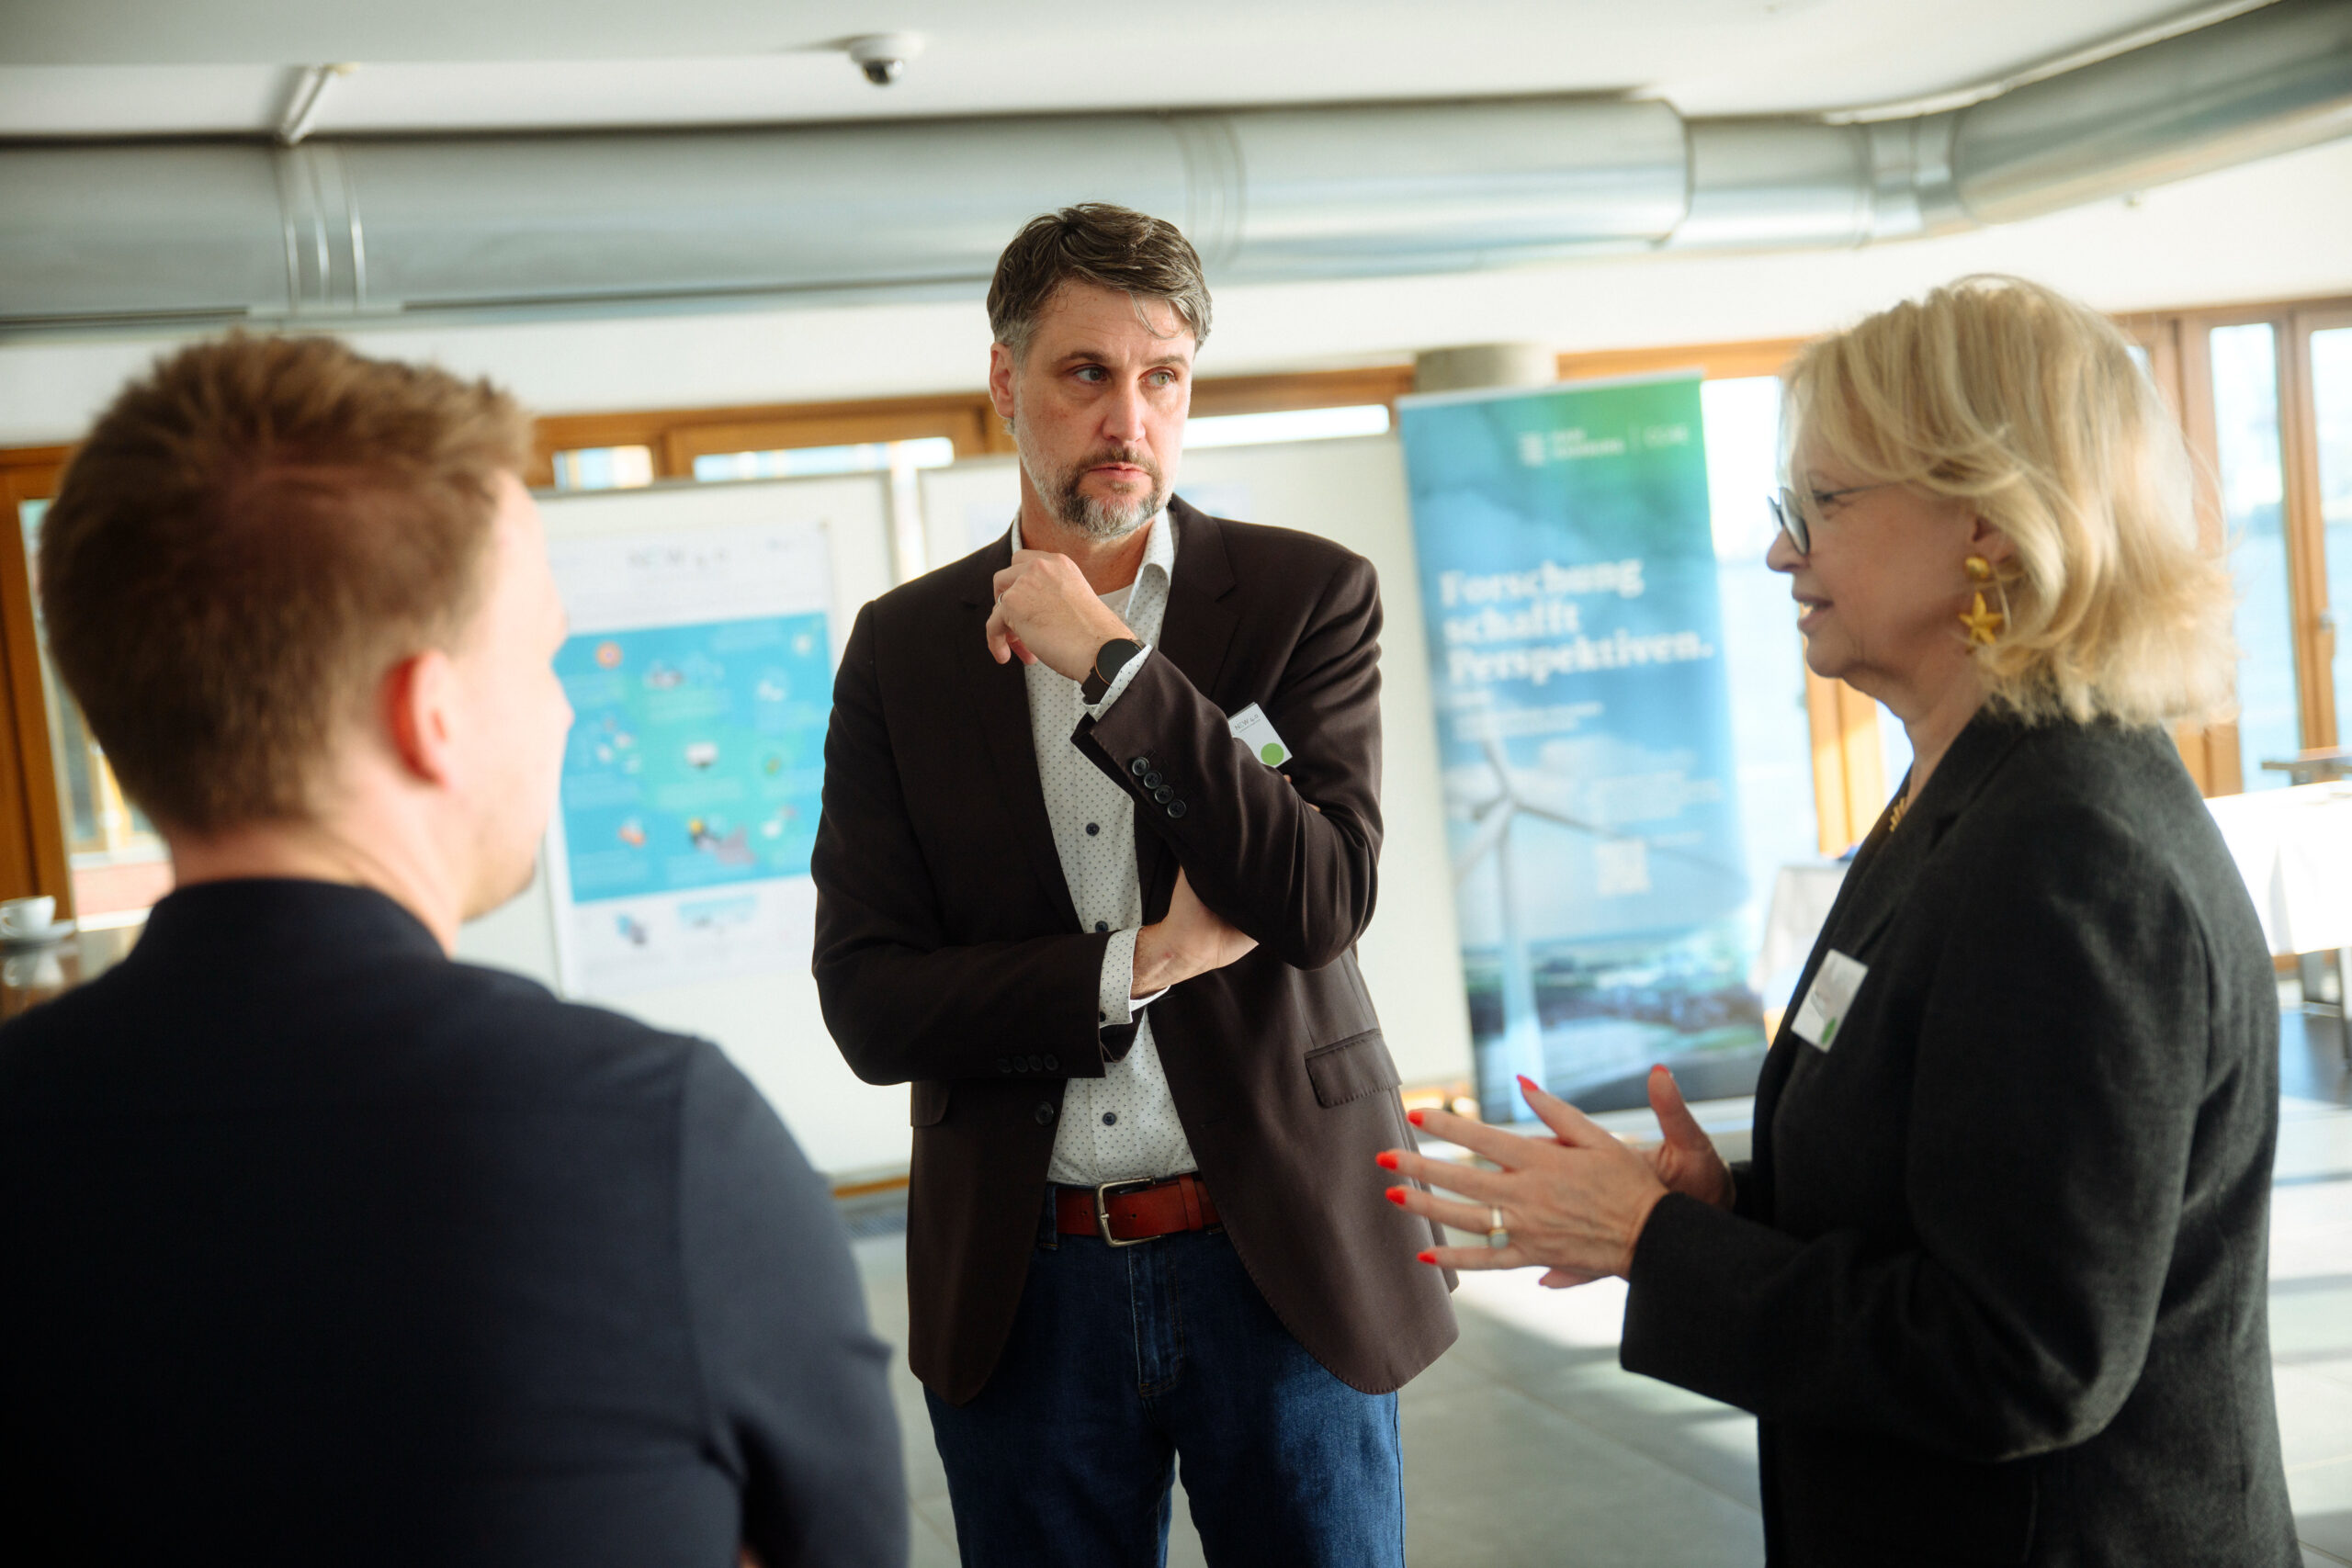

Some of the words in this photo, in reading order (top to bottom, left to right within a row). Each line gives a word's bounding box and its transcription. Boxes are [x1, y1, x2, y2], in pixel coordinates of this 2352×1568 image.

[1442, 559, 1644, 605] Forschung
[1445, 599, 1578, 642] schafft
[1449, 629, 1713, 684] Perspektiven.
